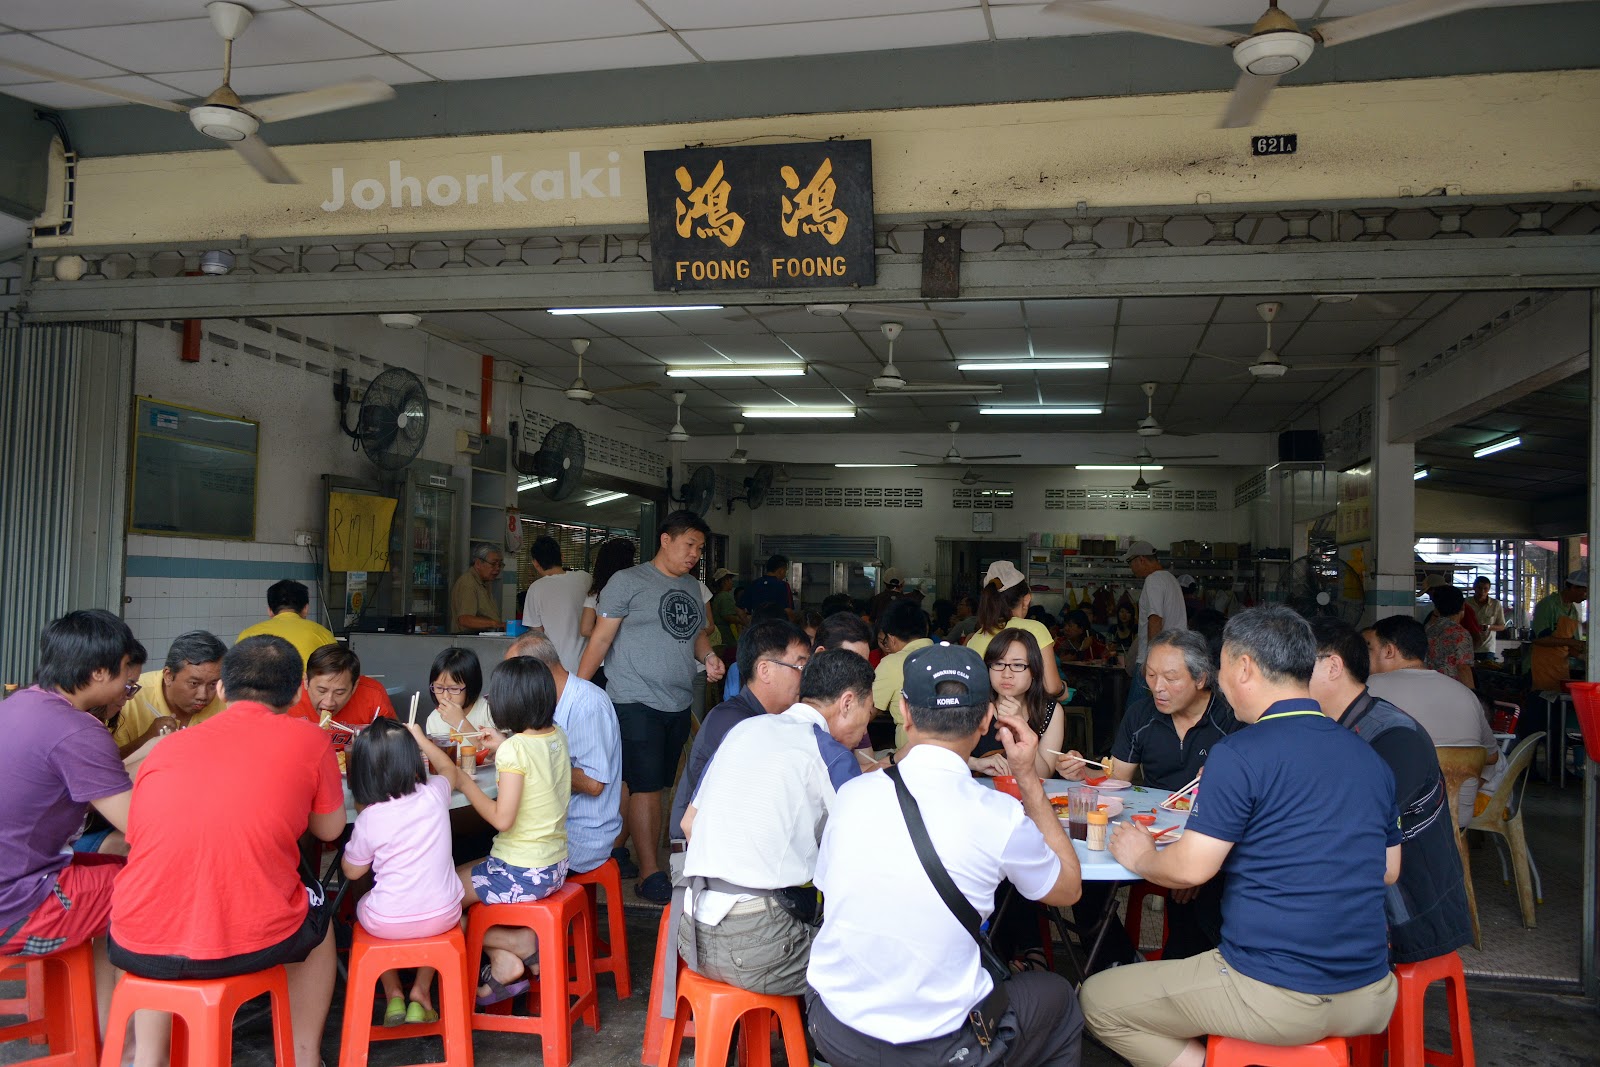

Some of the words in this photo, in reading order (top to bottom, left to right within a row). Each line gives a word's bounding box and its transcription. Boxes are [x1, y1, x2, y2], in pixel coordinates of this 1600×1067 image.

[675, 259, 750, 281] FOONG
[772, 256, 847, 278] FOONG
[932, 669, 956, 679] MORNING
[957, 671, 970, 679] CALM
[936, 698, 960, 706] KOREA
